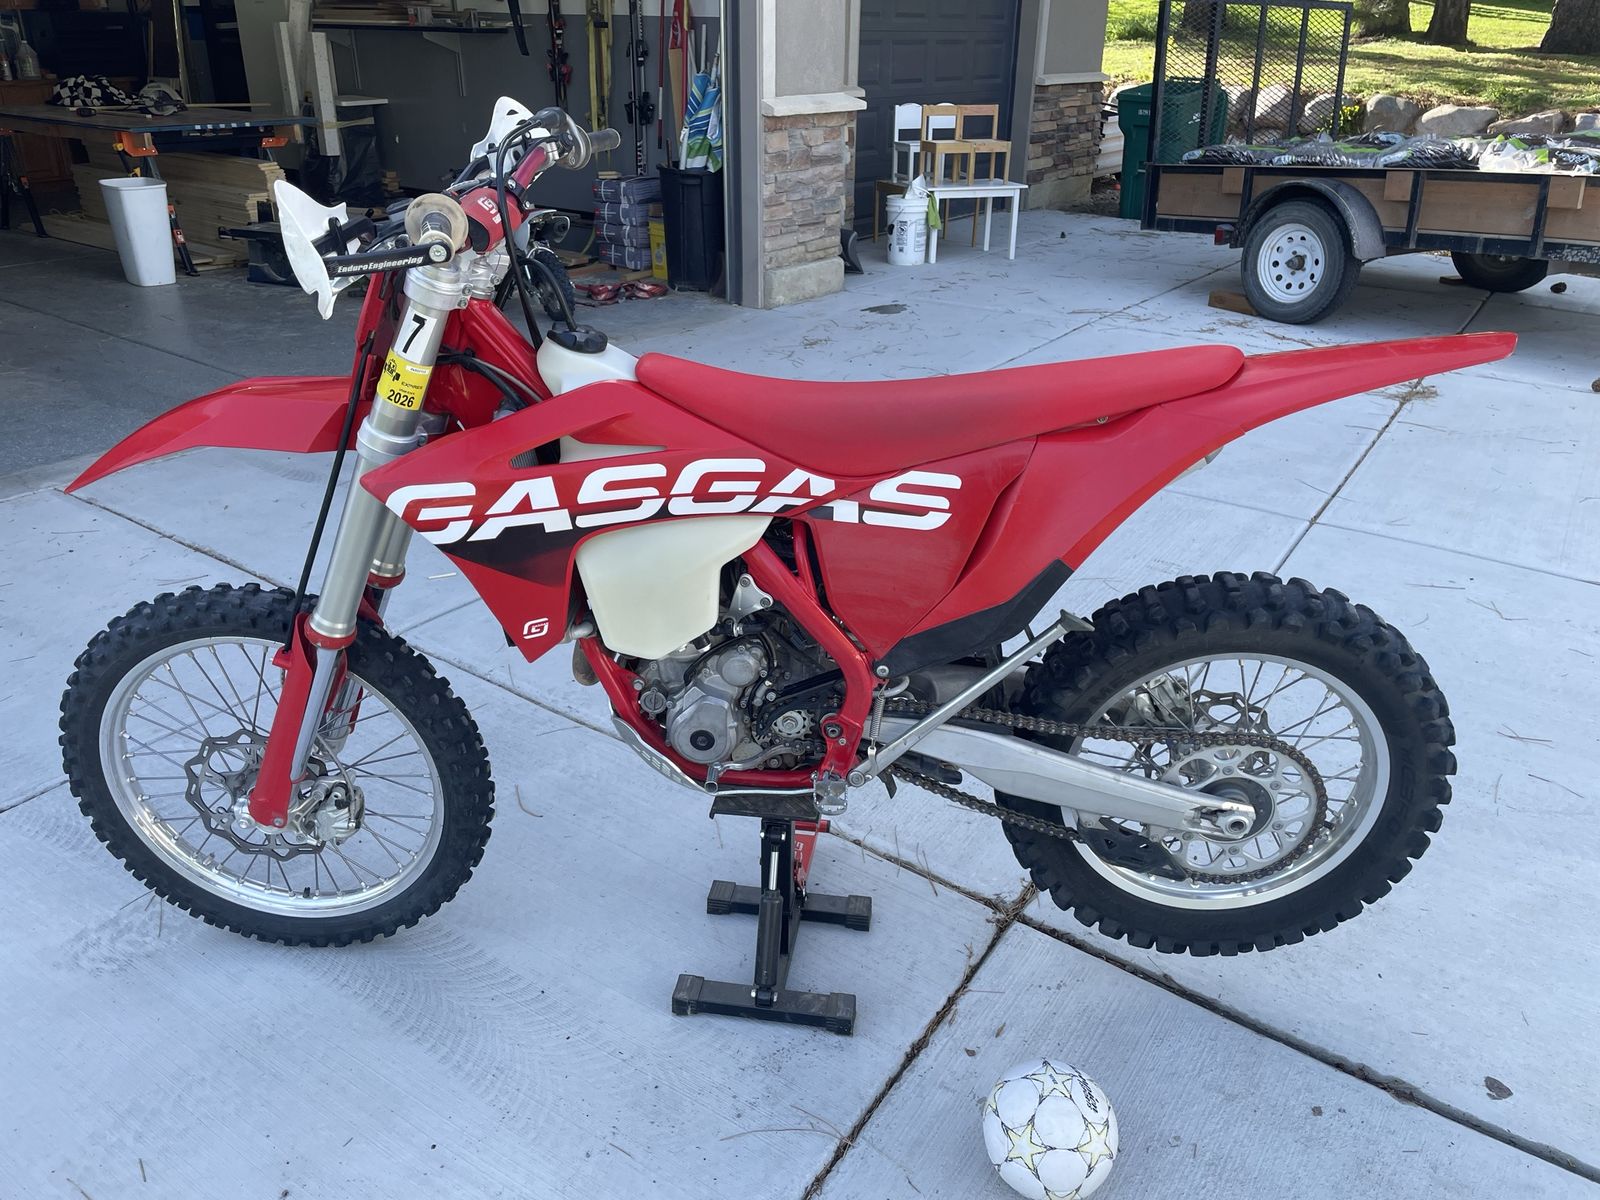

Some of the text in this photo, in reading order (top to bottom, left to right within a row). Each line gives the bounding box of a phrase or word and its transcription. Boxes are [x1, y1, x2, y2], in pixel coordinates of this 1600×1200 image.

[402, 313, 427, 354] 7
[387, 389, 415, 408] 2026
[385, 458, 963, 545] GASGAS
